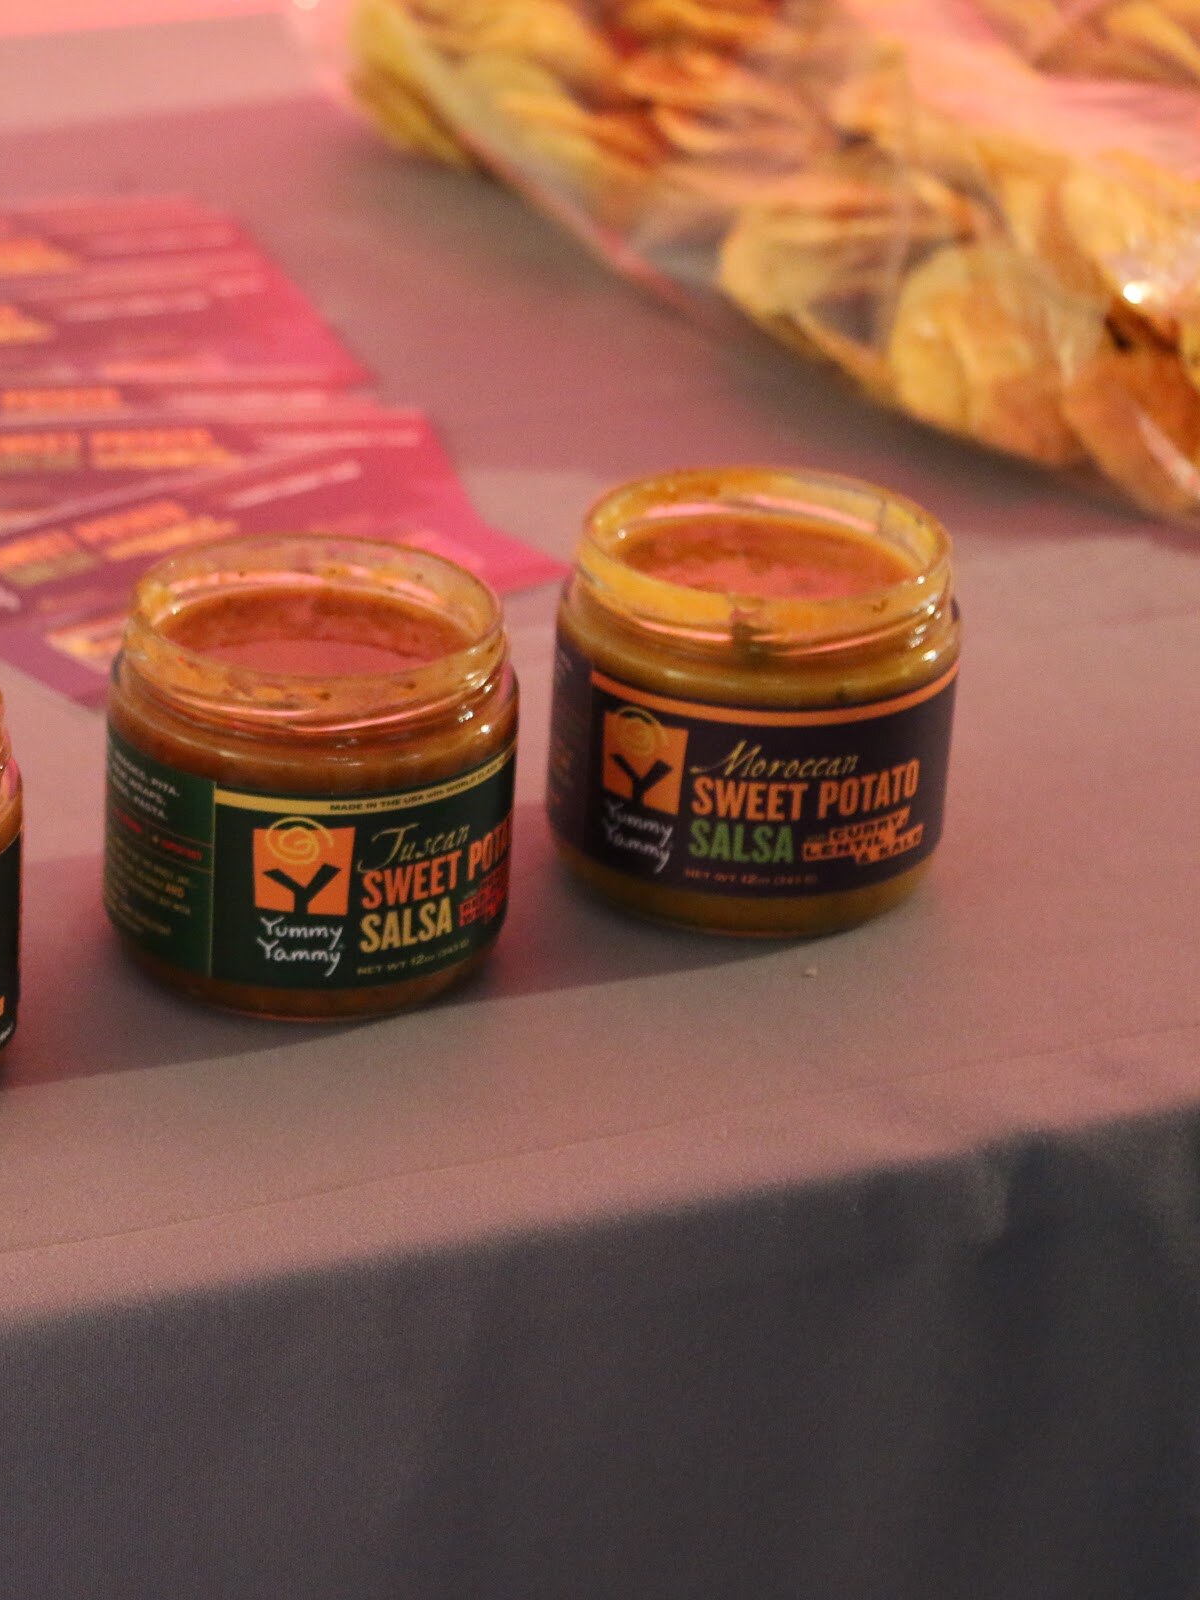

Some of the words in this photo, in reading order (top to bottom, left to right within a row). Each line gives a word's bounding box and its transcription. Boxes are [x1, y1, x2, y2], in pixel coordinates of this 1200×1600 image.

[690, 739, 860, 779] Moroccan
[330, 802, 363, 812] MADE
[366, 802, 377, 810] IN
[380, 799, 401, 809] THE
[691, 778, 808, 821] SWEET
[817, 757, 921, 819] POTATO
[357, 821, 470, 873] Tuscan
[603, 822, 673, 873] Yammy
[688, 819, 794, 865] SALSA
[360, 850, 463, 910] SWEET
[259, 915, 343, 951] Yummy
[358, 897, 454, 955] SALSA
[257, 938, 343, 977] Yammy
[357, 964, 383, 976] NET
